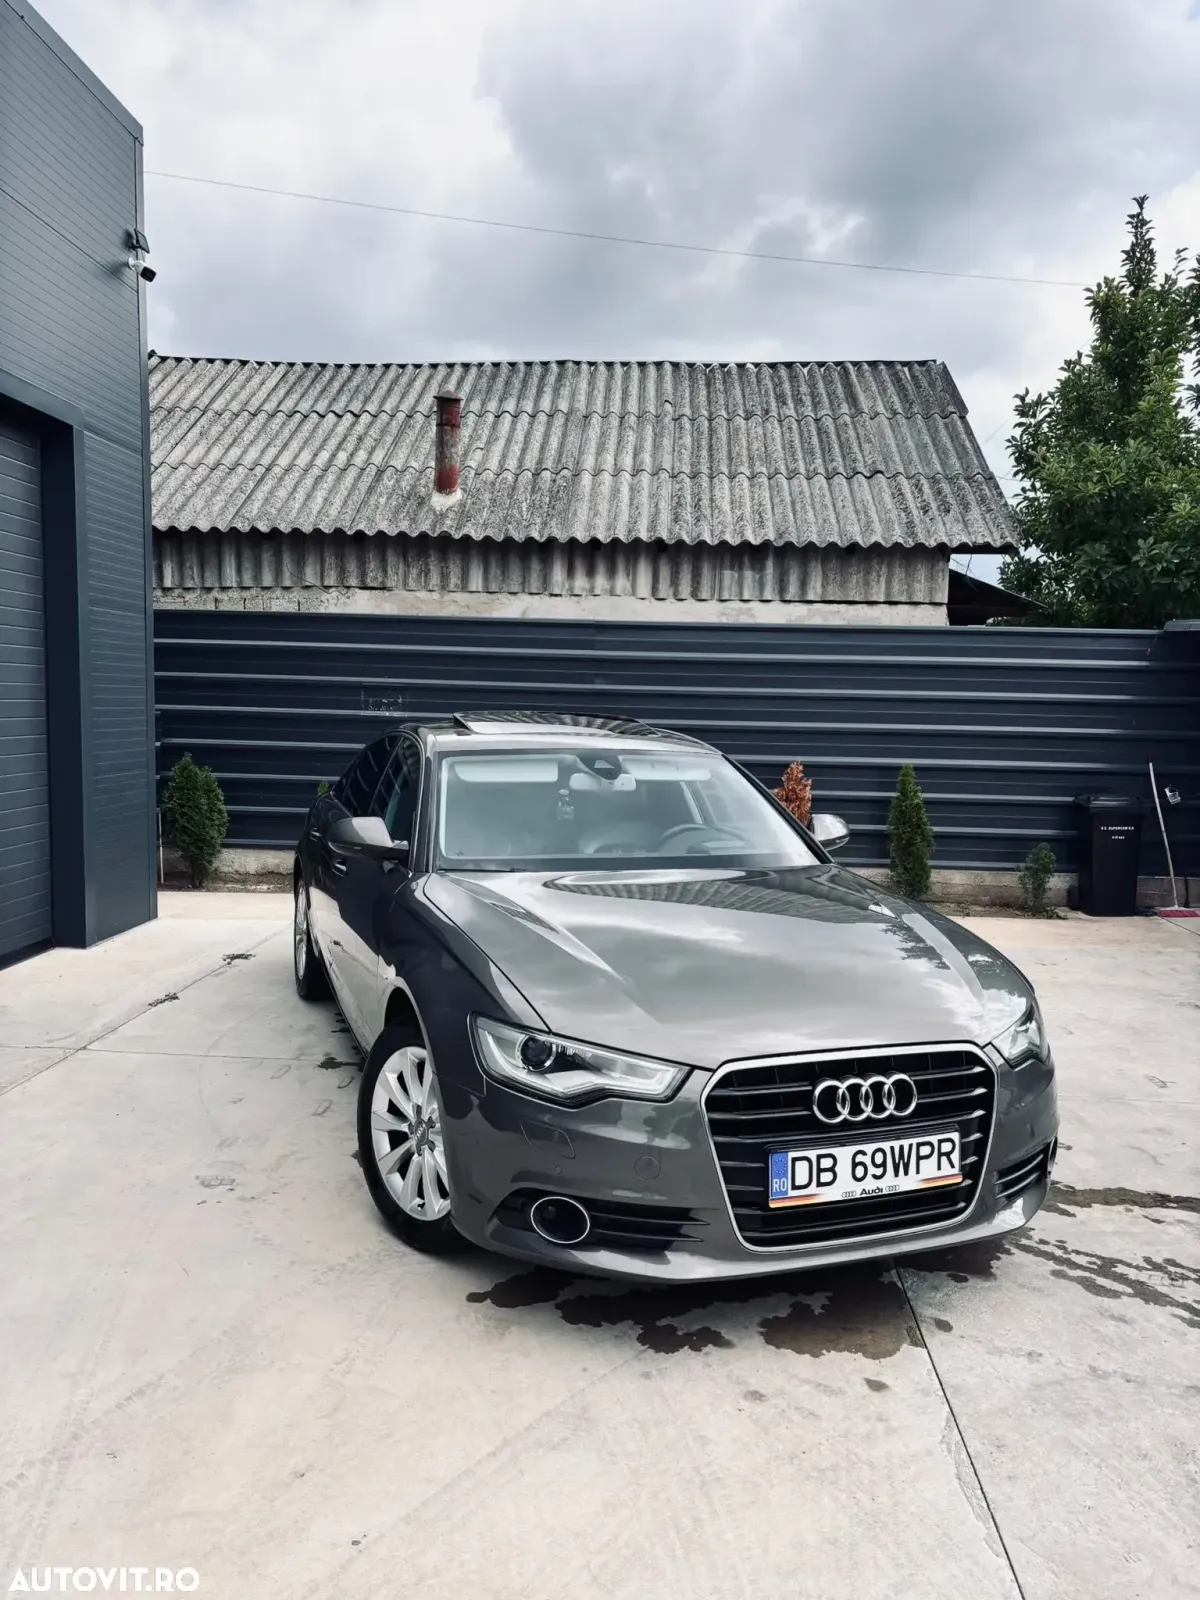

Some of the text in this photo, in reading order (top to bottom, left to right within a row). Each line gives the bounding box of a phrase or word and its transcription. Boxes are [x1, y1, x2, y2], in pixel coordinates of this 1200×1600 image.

[791, 1137, 956, 1191] DB 69WPR
[773, 1178, 787, 1192] RO
[860, 1186, 884, 1196] Audi
